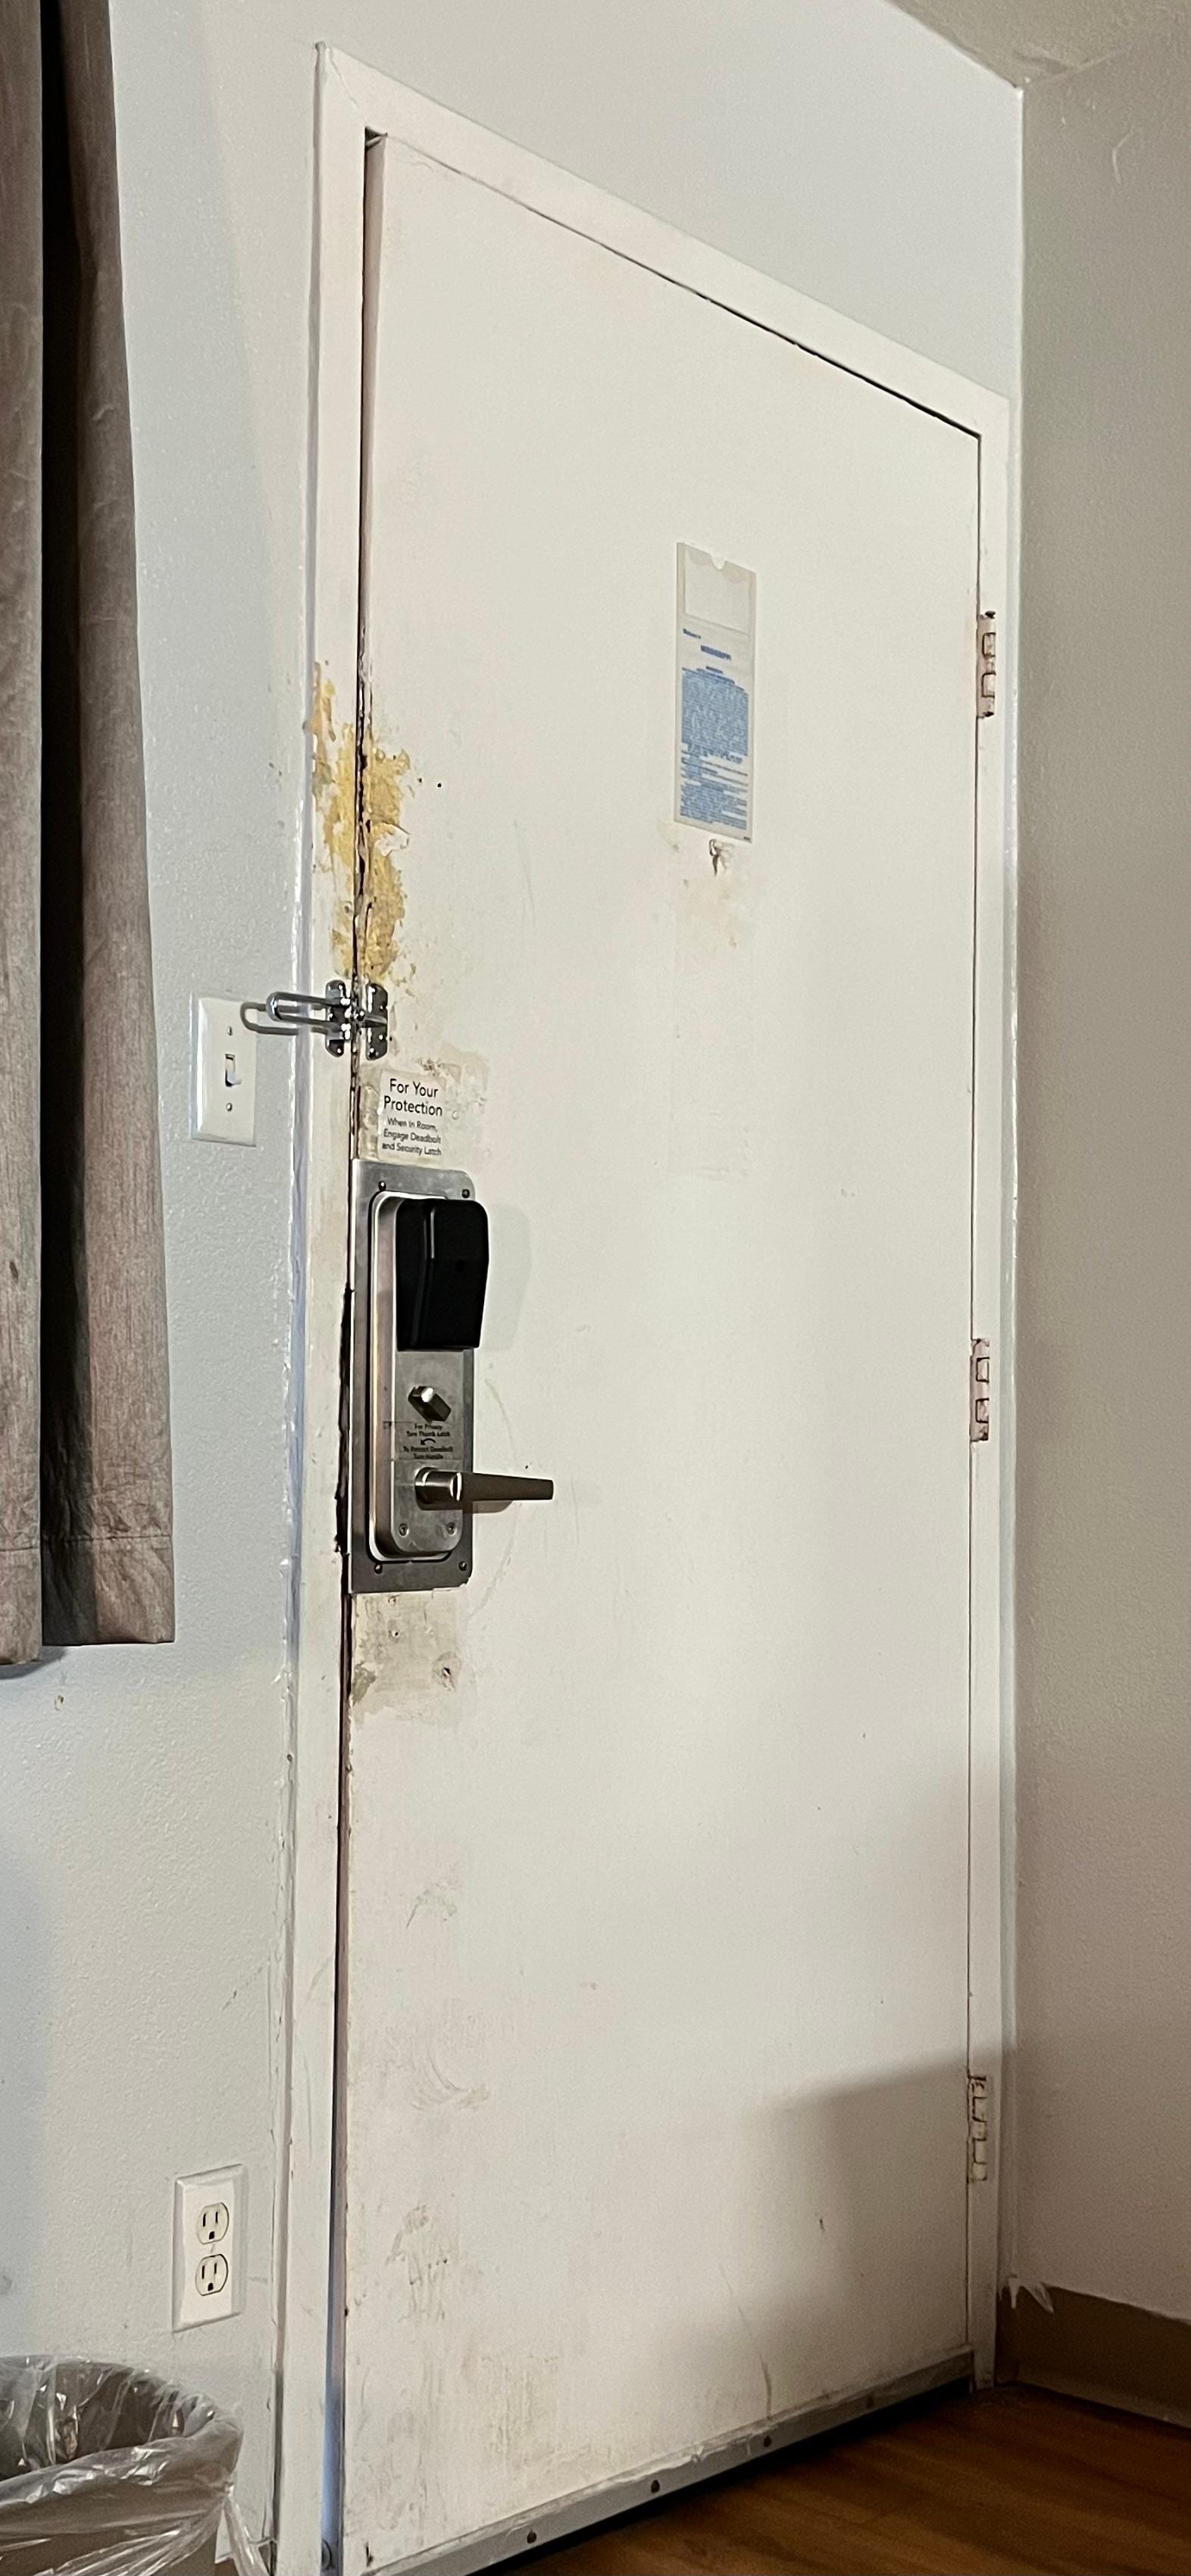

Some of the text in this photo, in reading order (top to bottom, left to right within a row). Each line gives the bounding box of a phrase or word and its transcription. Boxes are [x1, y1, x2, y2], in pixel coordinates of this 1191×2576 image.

[389, 1078, 439, 1098] For Your
[383, 1095, 442, 1116] Protection
[387, 1116, 407, 1127] When
[383, 1128, 441, 1144] Engage Deadbolt
[382, 1142, 442, 1156] and Security Latch
